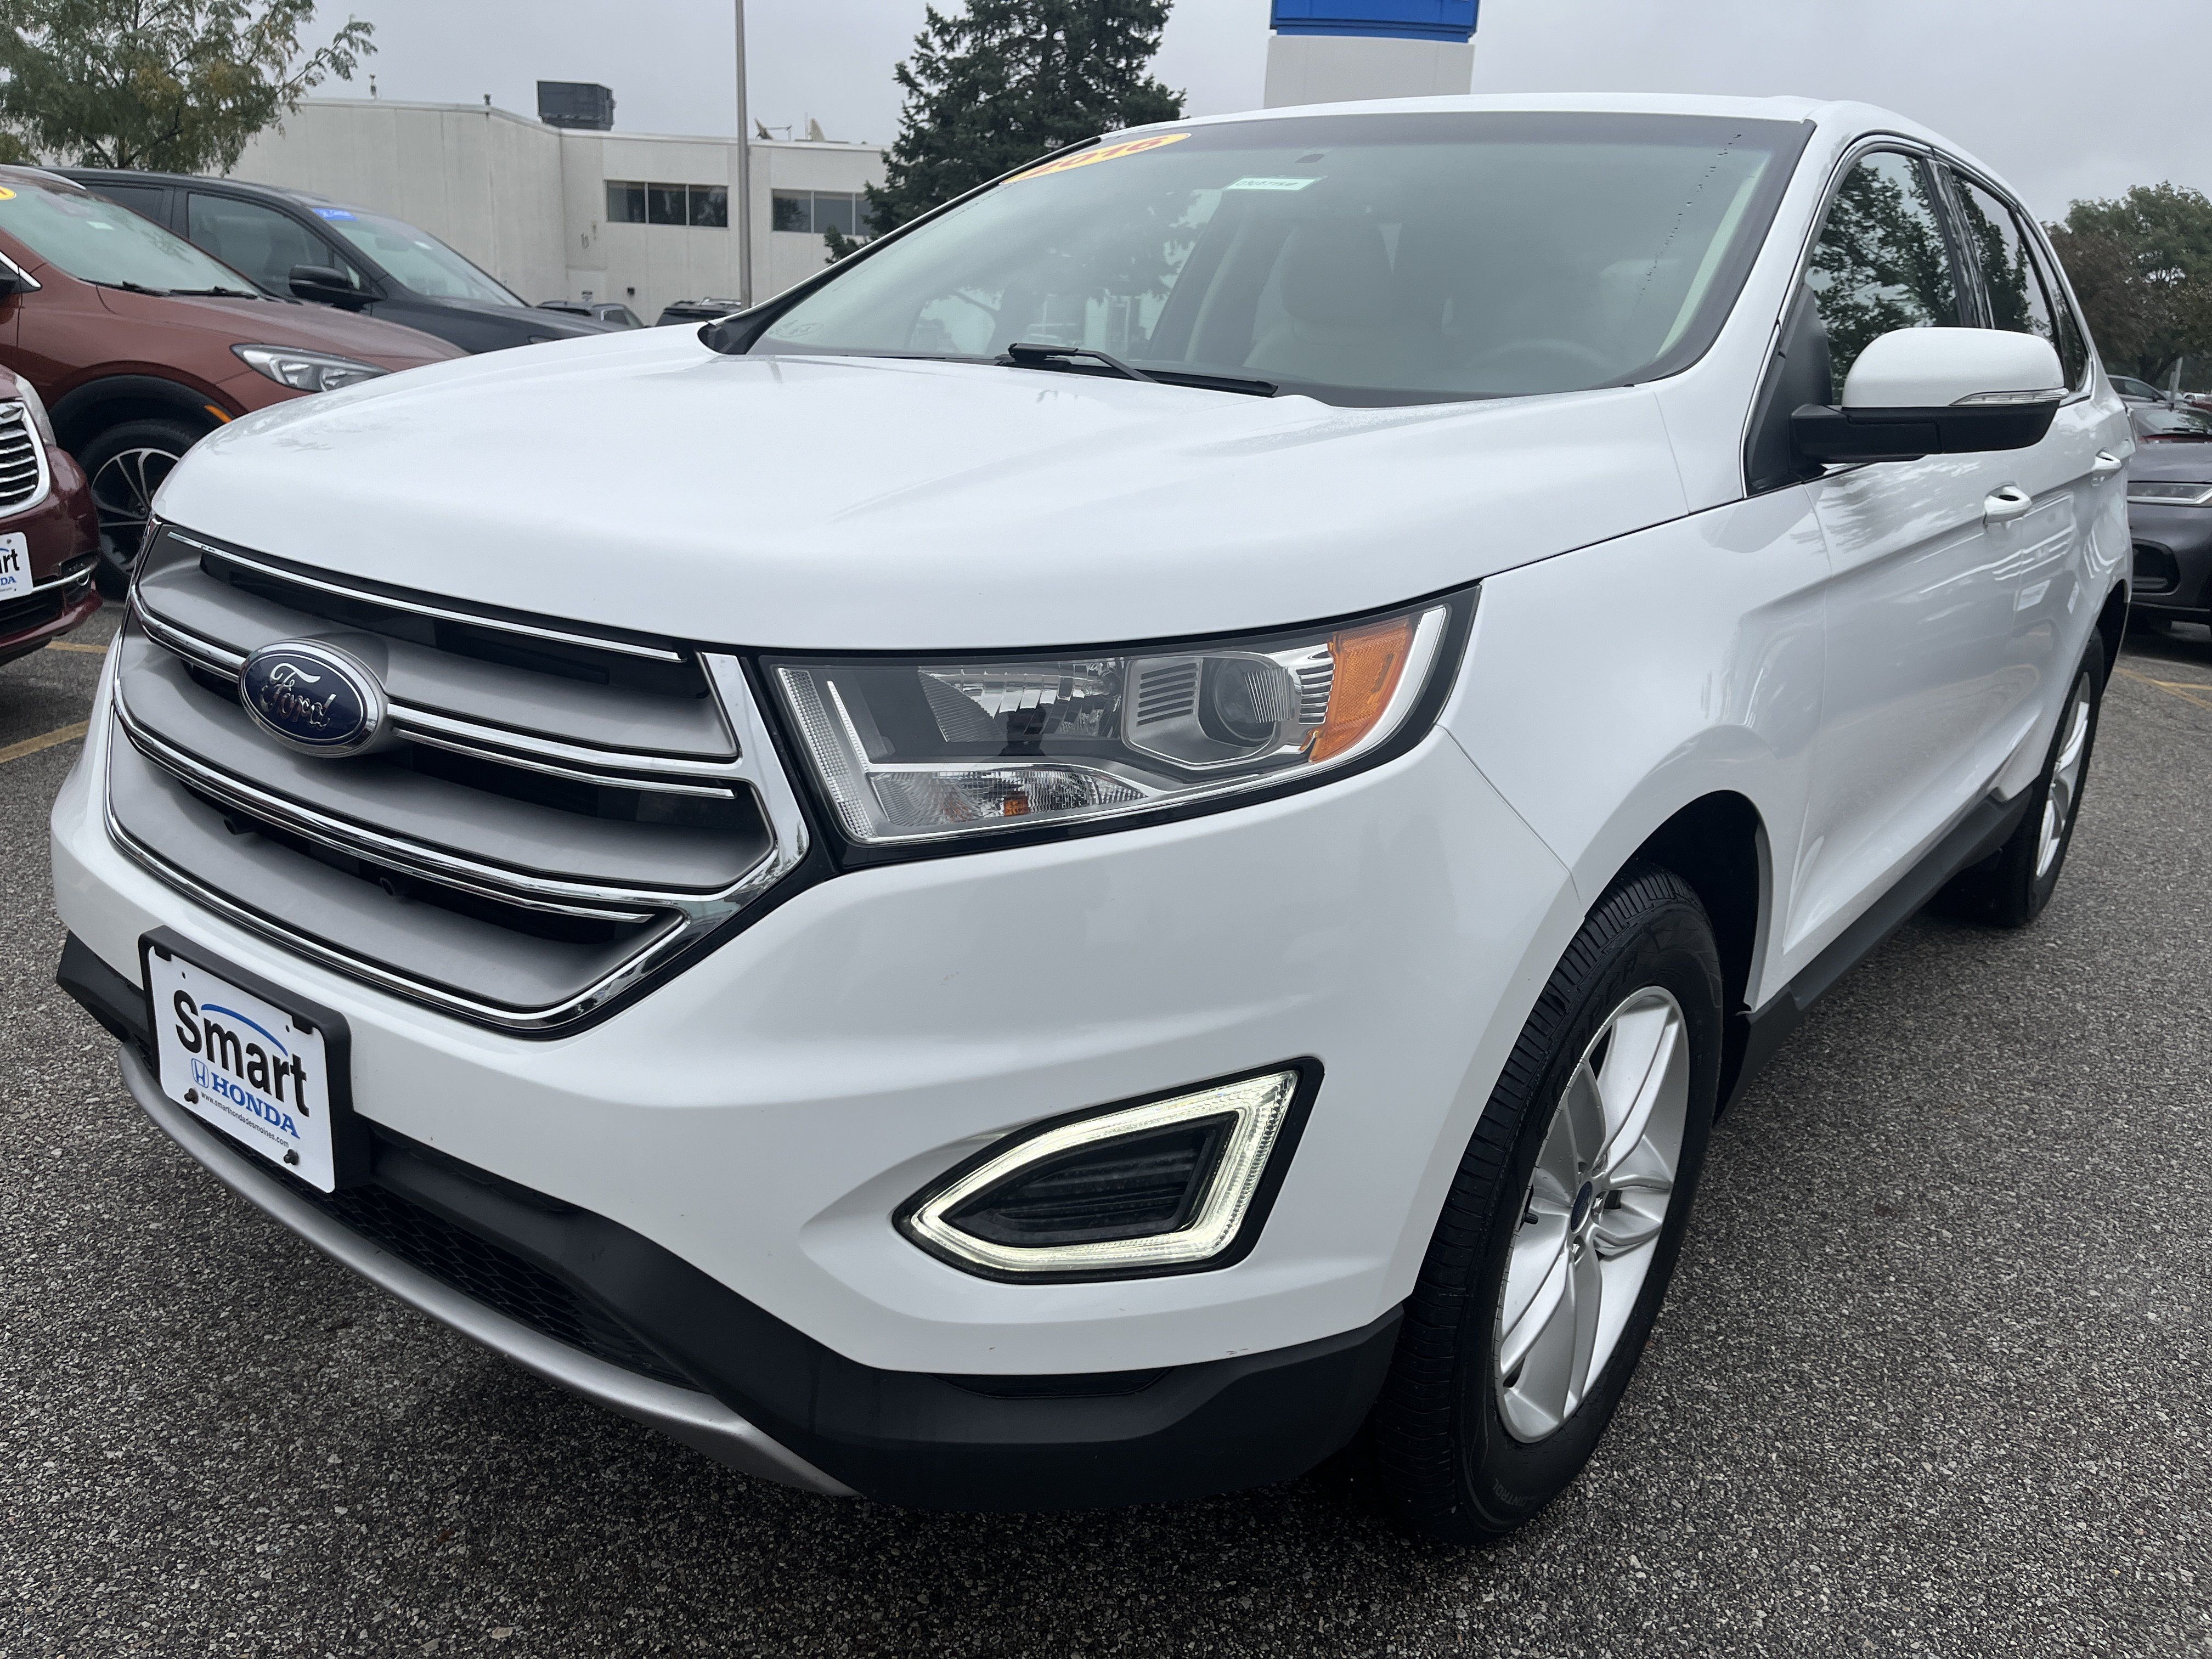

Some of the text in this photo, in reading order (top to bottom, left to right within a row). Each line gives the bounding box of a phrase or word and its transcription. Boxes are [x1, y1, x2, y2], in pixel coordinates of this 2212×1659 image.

[1018, 137, 1170, 180] 2016
[0, 549, 20, 573] rt
[259, 662, 336, 731] Ford
[173, 989, 309, 1118] Smart
[201, 1091, 289, 1148] www.smarthondadesmoines.com
[211, 1071, 301, 1139] HONDA
